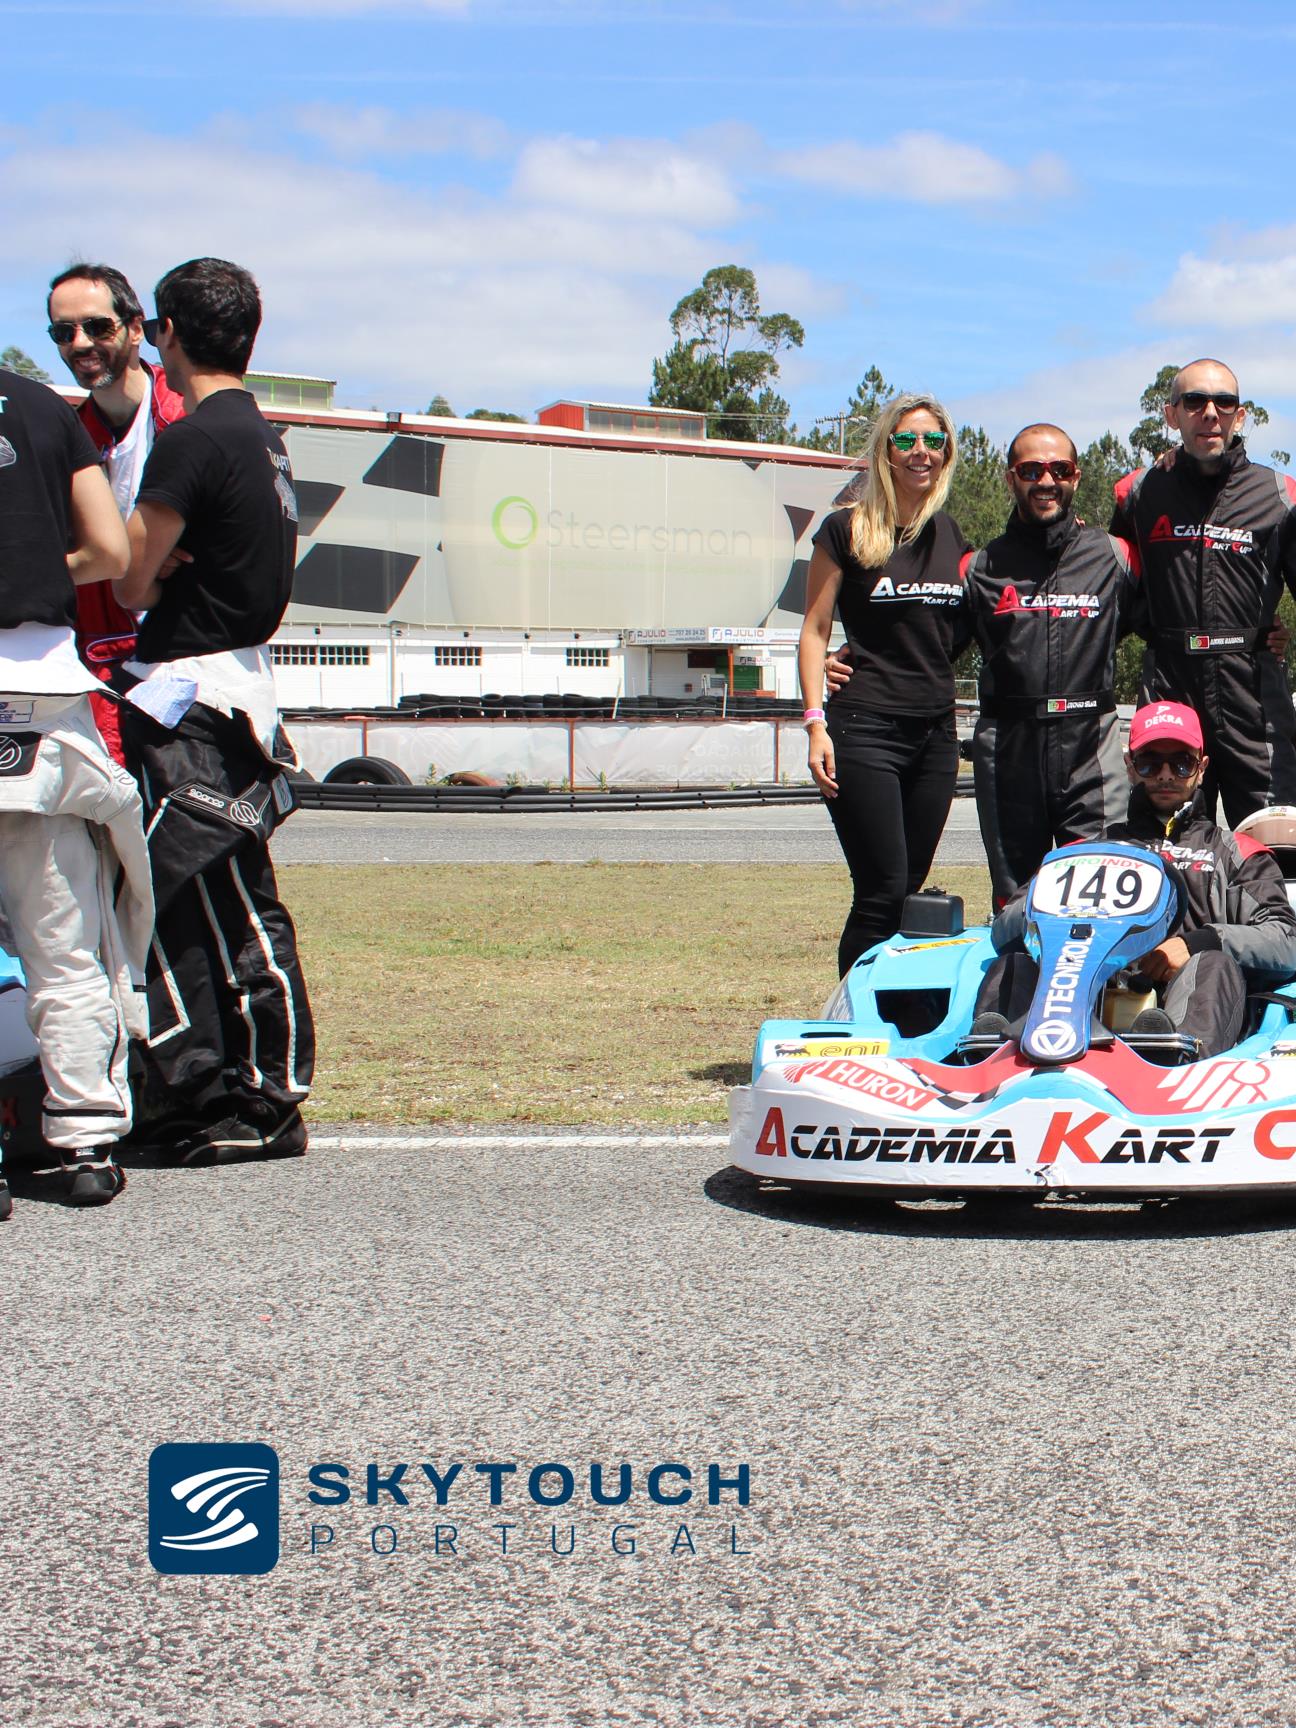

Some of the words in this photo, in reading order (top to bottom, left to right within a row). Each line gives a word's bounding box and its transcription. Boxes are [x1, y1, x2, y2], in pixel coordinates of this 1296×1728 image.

[546, 509, 753, 557] Steersman
[1151, 514, 1253, 543] ACADEMIA
[1231, 541, 1252, 554] CUP
[996, 584, 1100, 609] ACADEMIA
[1049, 606, 1079, 618] KART
[1080, 607, 1100, 618] CUP
[1145, 714, 1183, 728] DEKRA
[1054, 857, 1144, 869] EUROINDY
[1055, 865, 1142, 909] 149
[1043, 928, 1096, 1018] TECNIROL
[819, 1041, 880, 1057] eni
[829, 1061, 927, 1107] HURON
[755, 1106, 1016, 1163] ACADEMIA
[1036, 1111, 1236, 1163] KART
